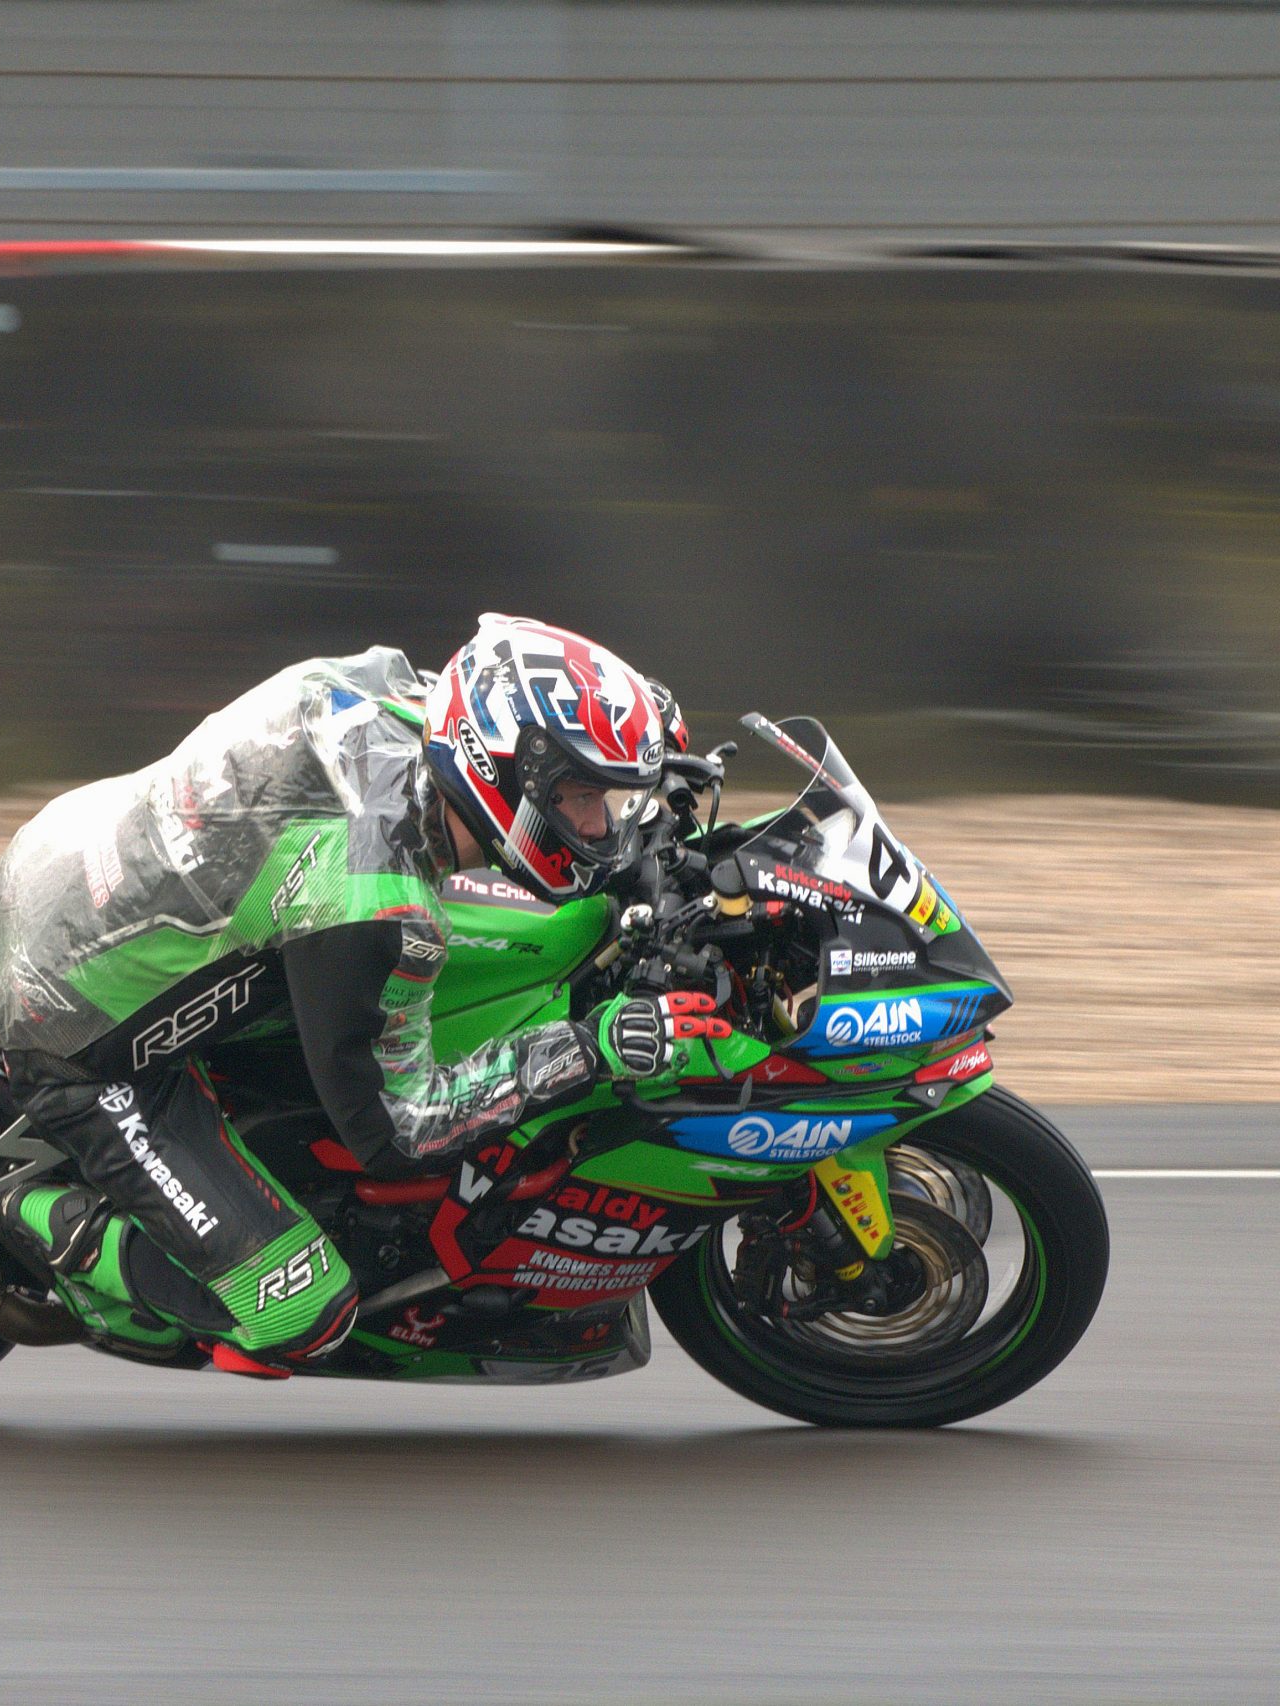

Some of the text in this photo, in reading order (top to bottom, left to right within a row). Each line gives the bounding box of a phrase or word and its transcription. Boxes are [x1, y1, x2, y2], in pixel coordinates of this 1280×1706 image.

[460, 727, 495, 784] HJC
[270, 831, 321, 925] RST
[869, 822, 911, 900] 4
[450, 875, 537, 901] The Chu
[758, 870, 865, 925] Kawasaki
[853, 951, 917, 967] Silkolene
[133, 963, 267, 1072] RST
[863, 1031, 922, 1047] STEELSTOCK
[948, 1049, 988, 1076] Ninja
[769, 1146, 840, 1160] STEELSTOCK
[118, 1112, 219, 1238] Kawasaki
[255, 1234, 330, 1313] RST
[512, 1266, 652, 1291] MOTORCYCLES
[529, 1250, 658, 1277] KNOWES MILL
